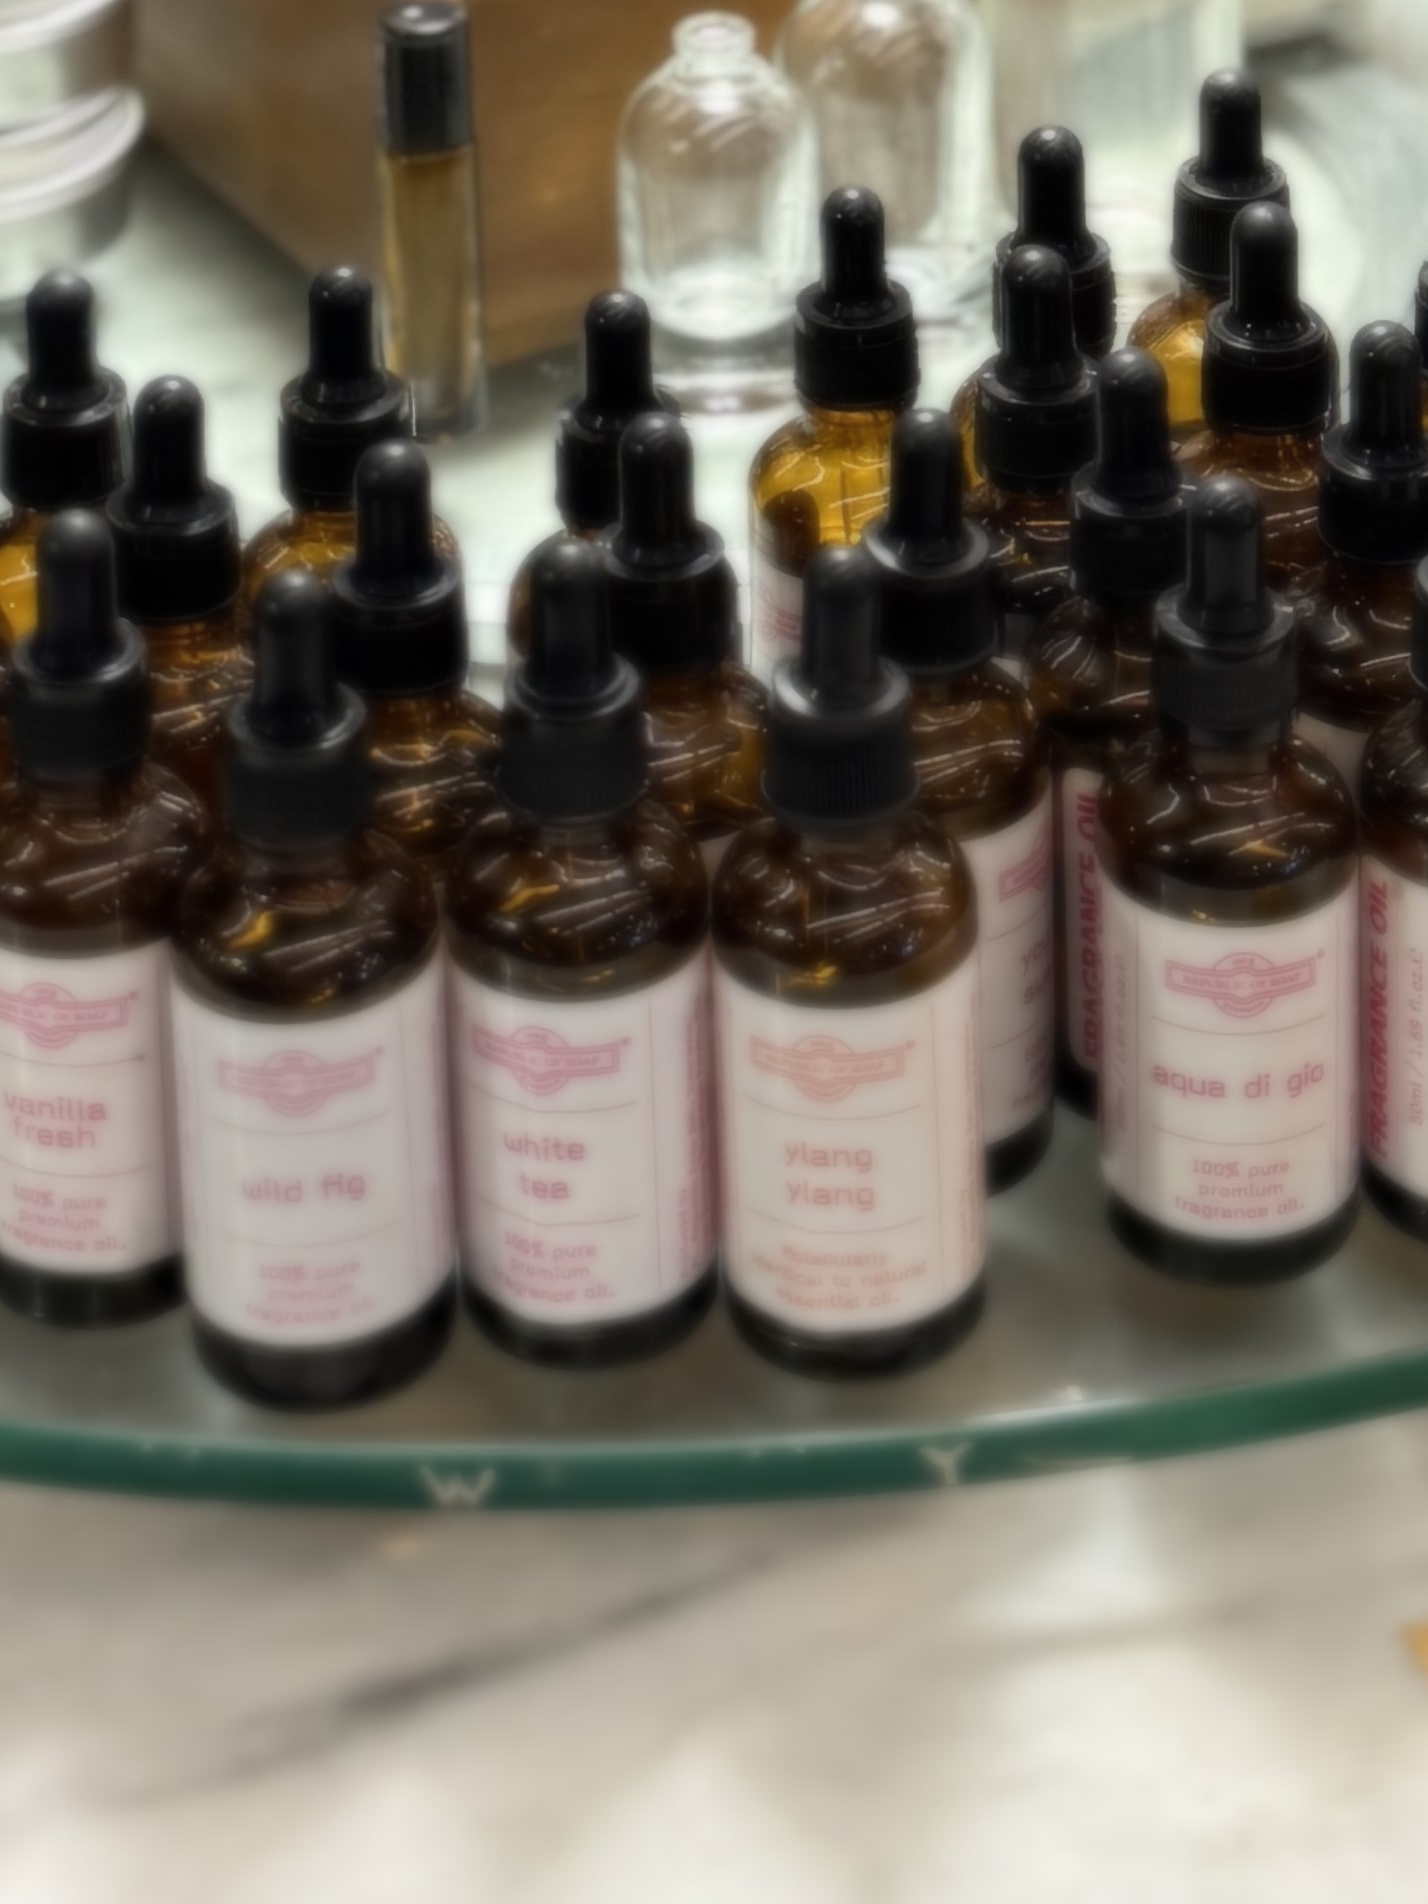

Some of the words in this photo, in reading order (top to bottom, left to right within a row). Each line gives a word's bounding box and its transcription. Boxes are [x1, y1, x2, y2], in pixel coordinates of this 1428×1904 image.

[1369, 879, 1389, 932] OIL
[1369, 940, 1389, 1158] FRAGRANCE
[1152, 1063, 1226, 1098] aqua
[1243, 1073, 1270, 1099] di
[1287, 1061, 1325, 1098] gio
[3, 1091, 108, 1121] vanilla
[12, 1115, 97, 1149] fresh
[503, 1130, 586, 1161] white
[784, 1139, 873, 1174] ylang
[1192, 1158, 1240, 1180] 100%
[1248, 1160, 1290, 1180] pure
[241, 1176, 302, 1203] wild
[322, 1172, 366, 1200] fig
[518, 1170, 570, 1200] tea
[784, 1179, 876, 1212] ylang
[1197, 1182, 1284, 1199] premium
[1174, 1195, 1269, 1220] fragrance
[924, 1443, 970, 1487] Y
[425, 1467, 492, 1505] W
